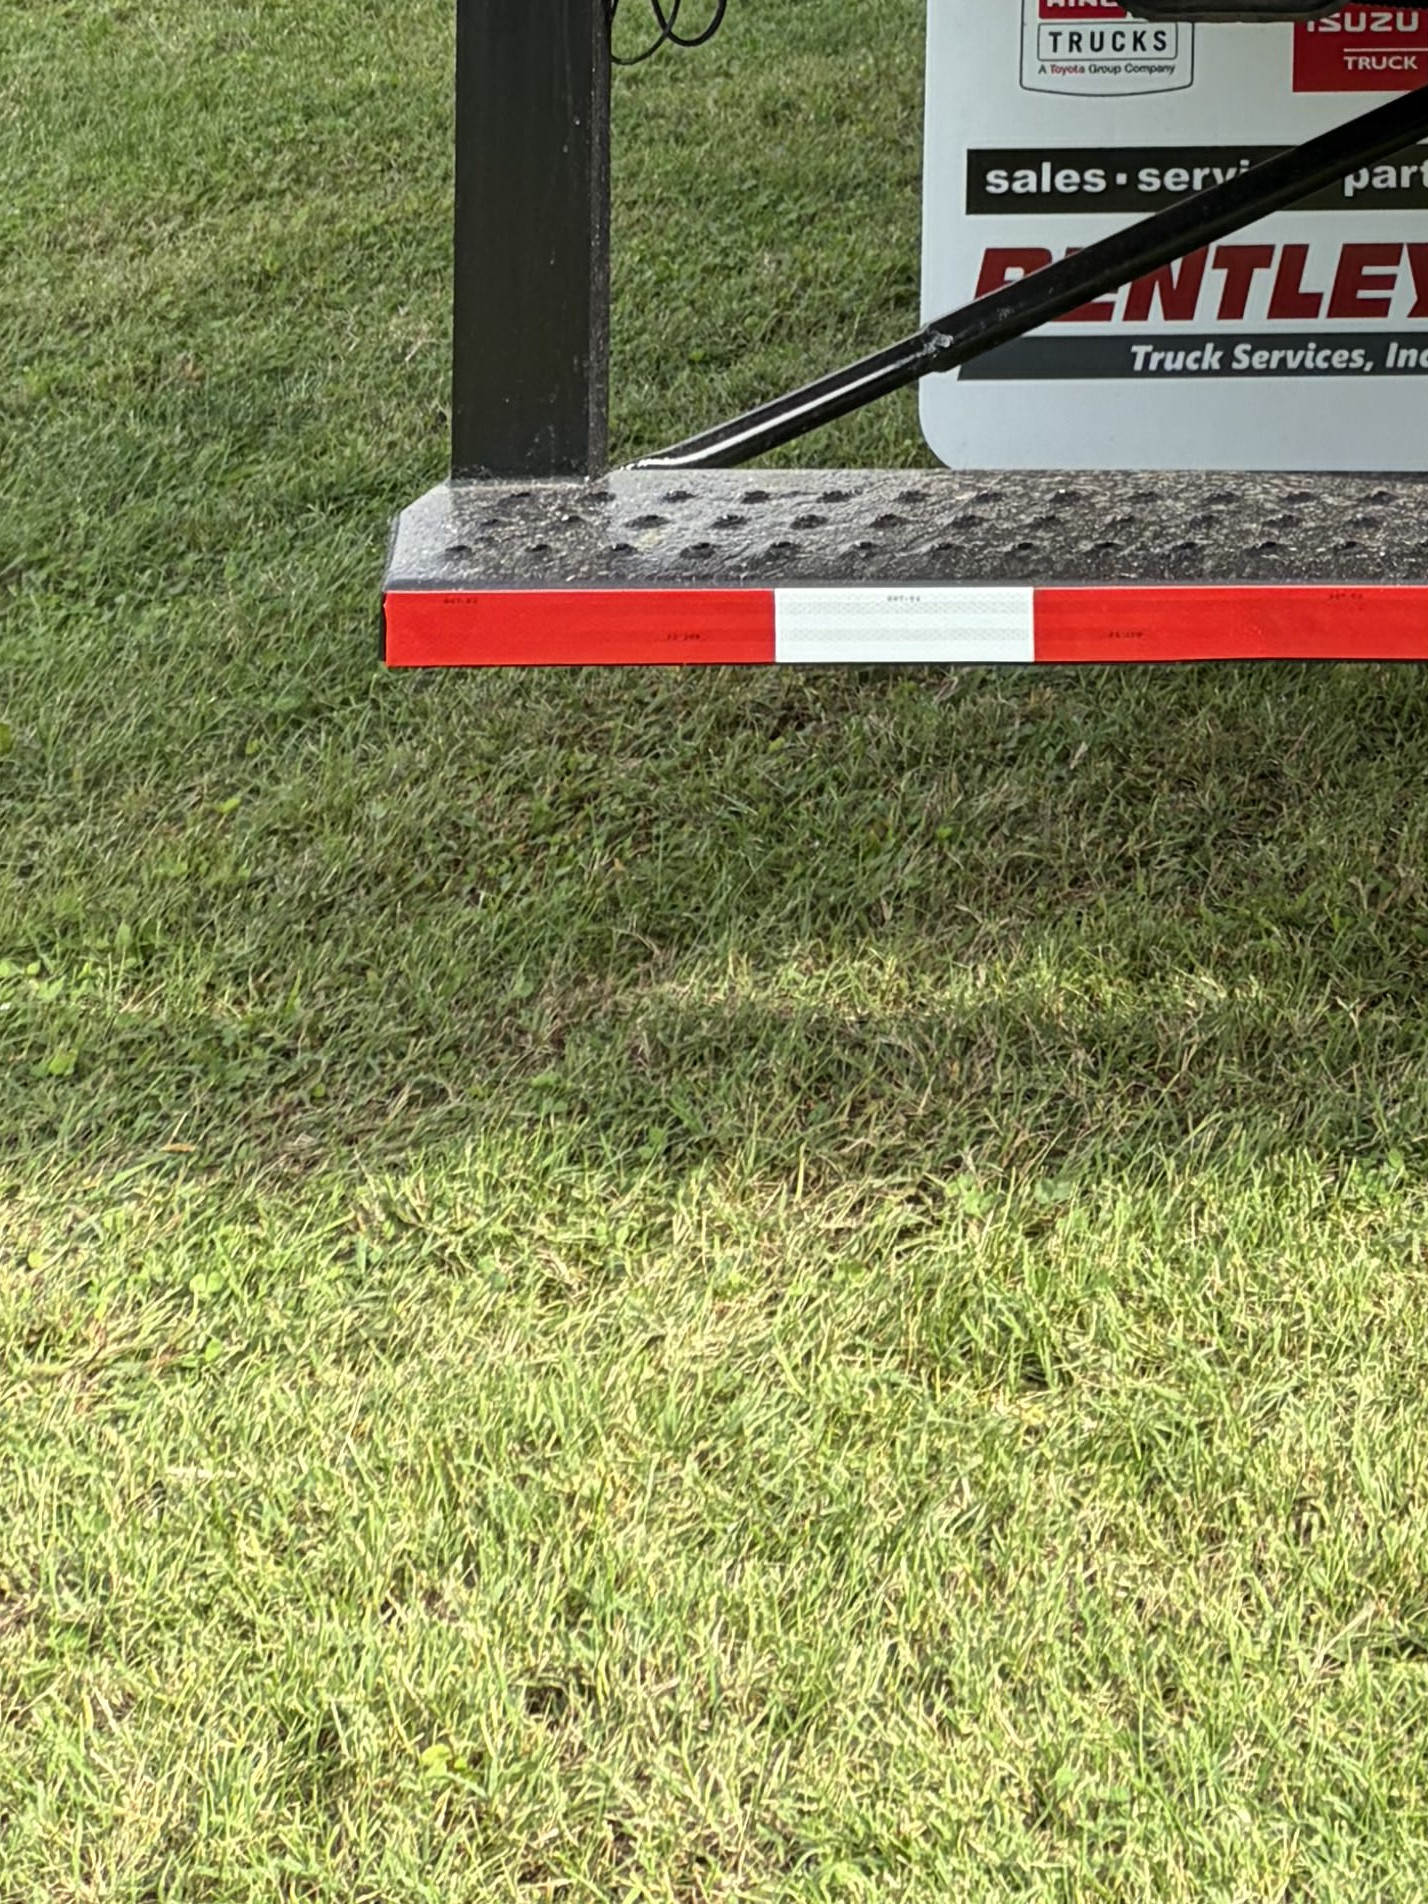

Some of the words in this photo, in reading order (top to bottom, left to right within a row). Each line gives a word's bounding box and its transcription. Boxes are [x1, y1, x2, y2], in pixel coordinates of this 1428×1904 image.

[1048, 30, 1167, 53] TRUCKS
[1038, 64, 1047, 74] A
[1050, 64, 1085, 76] Toyota
[1089, 64, 1121, 75] Group
[1125, 63, 1175, 75] Company
[1343, 56, 1418, 70] TRUCK
[985, 161, 1106, 194] sales
[1130, 343, 1223, 372] Truck
[1232, 344, 1374, 374] Services,
